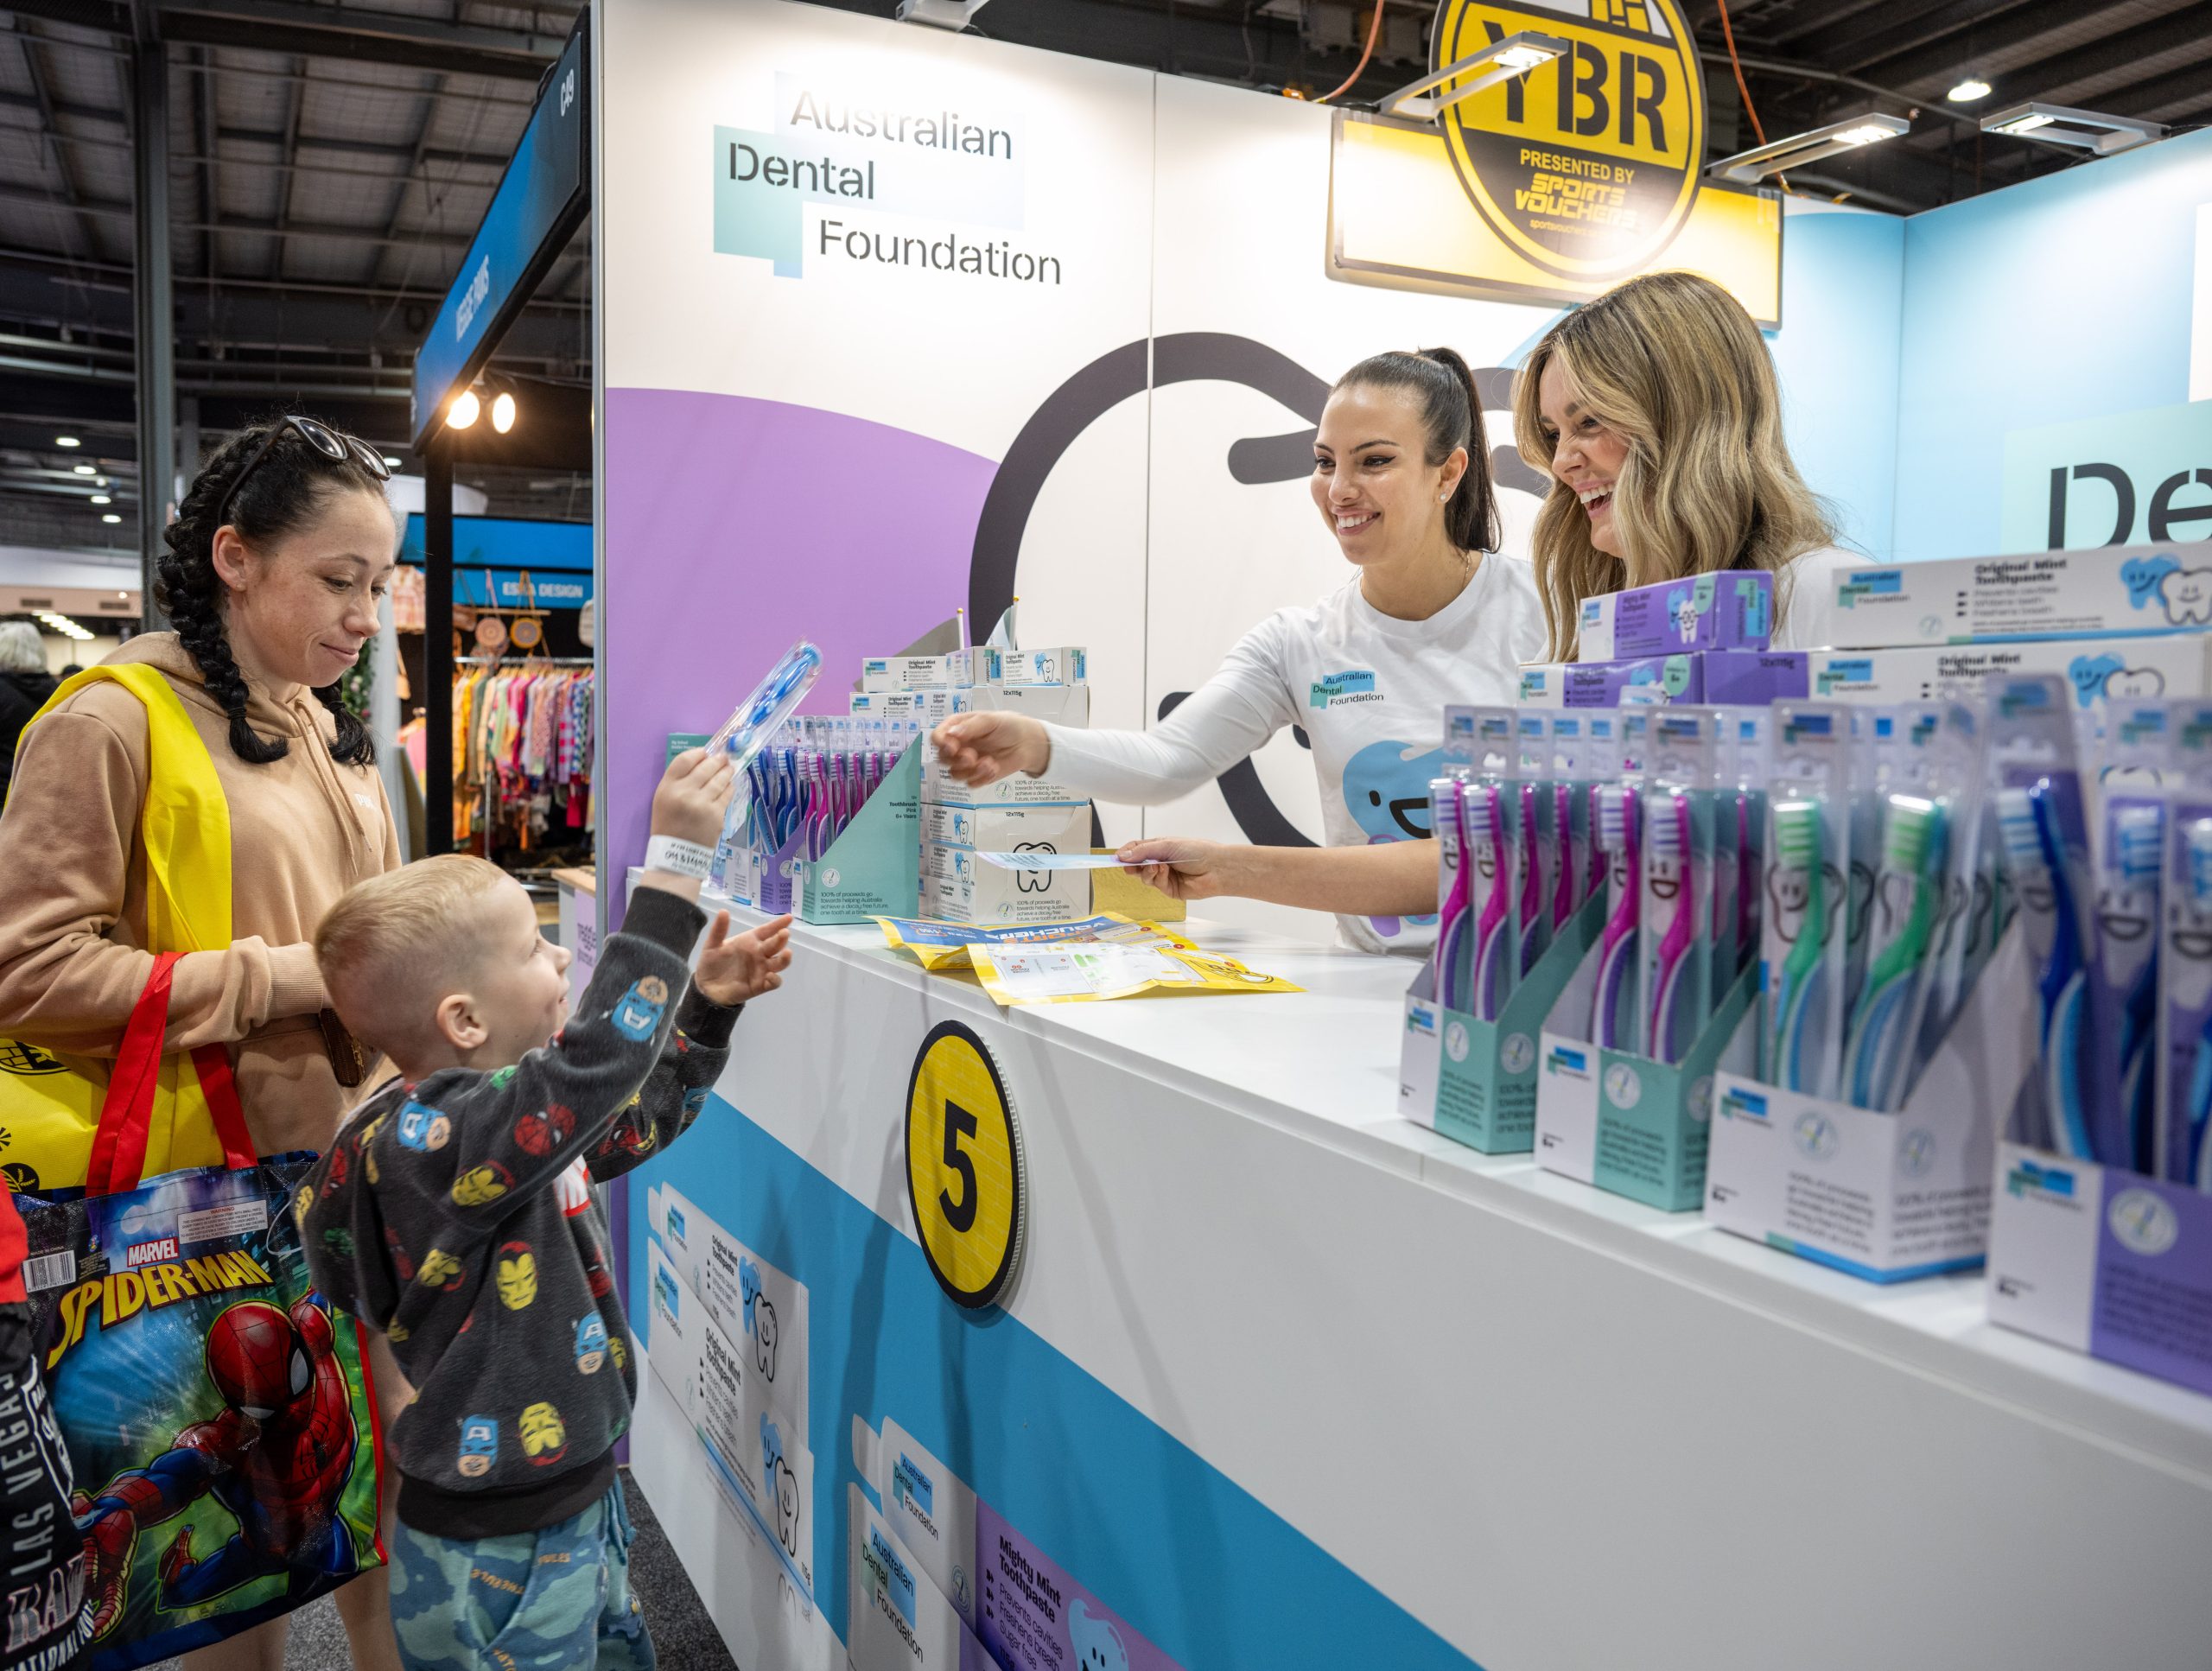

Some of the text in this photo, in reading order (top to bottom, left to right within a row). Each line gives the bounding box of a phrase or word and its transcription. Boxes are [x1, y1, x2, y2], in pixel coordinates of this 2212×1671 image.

[1482, 20, 1669, 153] YBR
[790, 90, 1012, 160] Australian
[730, 142, 874, 200] Dental
[1520, 149, 1635, 185] PRESENTED BY
[1530, 172, 1626, 206] SPORTS
[1515, 188, 1637, 228] VOUCHERS
[820, 219, 1061, 284] Foundation
[538, 582, 583, 598] DESIGN
[1313, 684, 1342, 696] Dental
[1325, 671, 1372, 685] Australian
[1330, 692, 1384, 706] Foundation
[939, 1098, 978, 1233] 5
[210, 1206, 235, 1215] WARNING
[128, 1238, 179, 1266] MARVEL
[712, 1235, 738, 1267] Original Mint
[712, 1246, 734, 1276] Toothpaste
[47, 1249, 275, 1370] SPIDER-MAN
[662, 1304, 683, 1339] Foundation
[705, 1344, 737, 1396] Toothpaste
[706, 1326, 741, 1386] Original Mint
[705, 1363, 739, 1420] Prevents cavities
[705, 1380, 734, 1428] Whitens teeth
[705, 1395, 737, 1451] Freshens breath
[893, 1465, 913, 1494] Dental
[902, 1458, 932, 1496] Australian
[10, 1501, 55, 1576] LAS
[905, 1496, 938, 1541] Foundation
[801, 1561, 811, 1586] 115g
[862, 1542, 888, 1589] Dental
[873, 1532, 913, 1598] Australian
[999, 1553, 1056, 1623] Toothpaste
[1000, 1534, 1061, 1608] Mighty Mint
[877, 1587, 924, 1663] Foundation
[1000, 1582, 1063, 1661] Prevents cavities
[1000, 1601, 1060, 1671] Freshens breath
[1000, 1619, 1037, 1670] Sugar free
